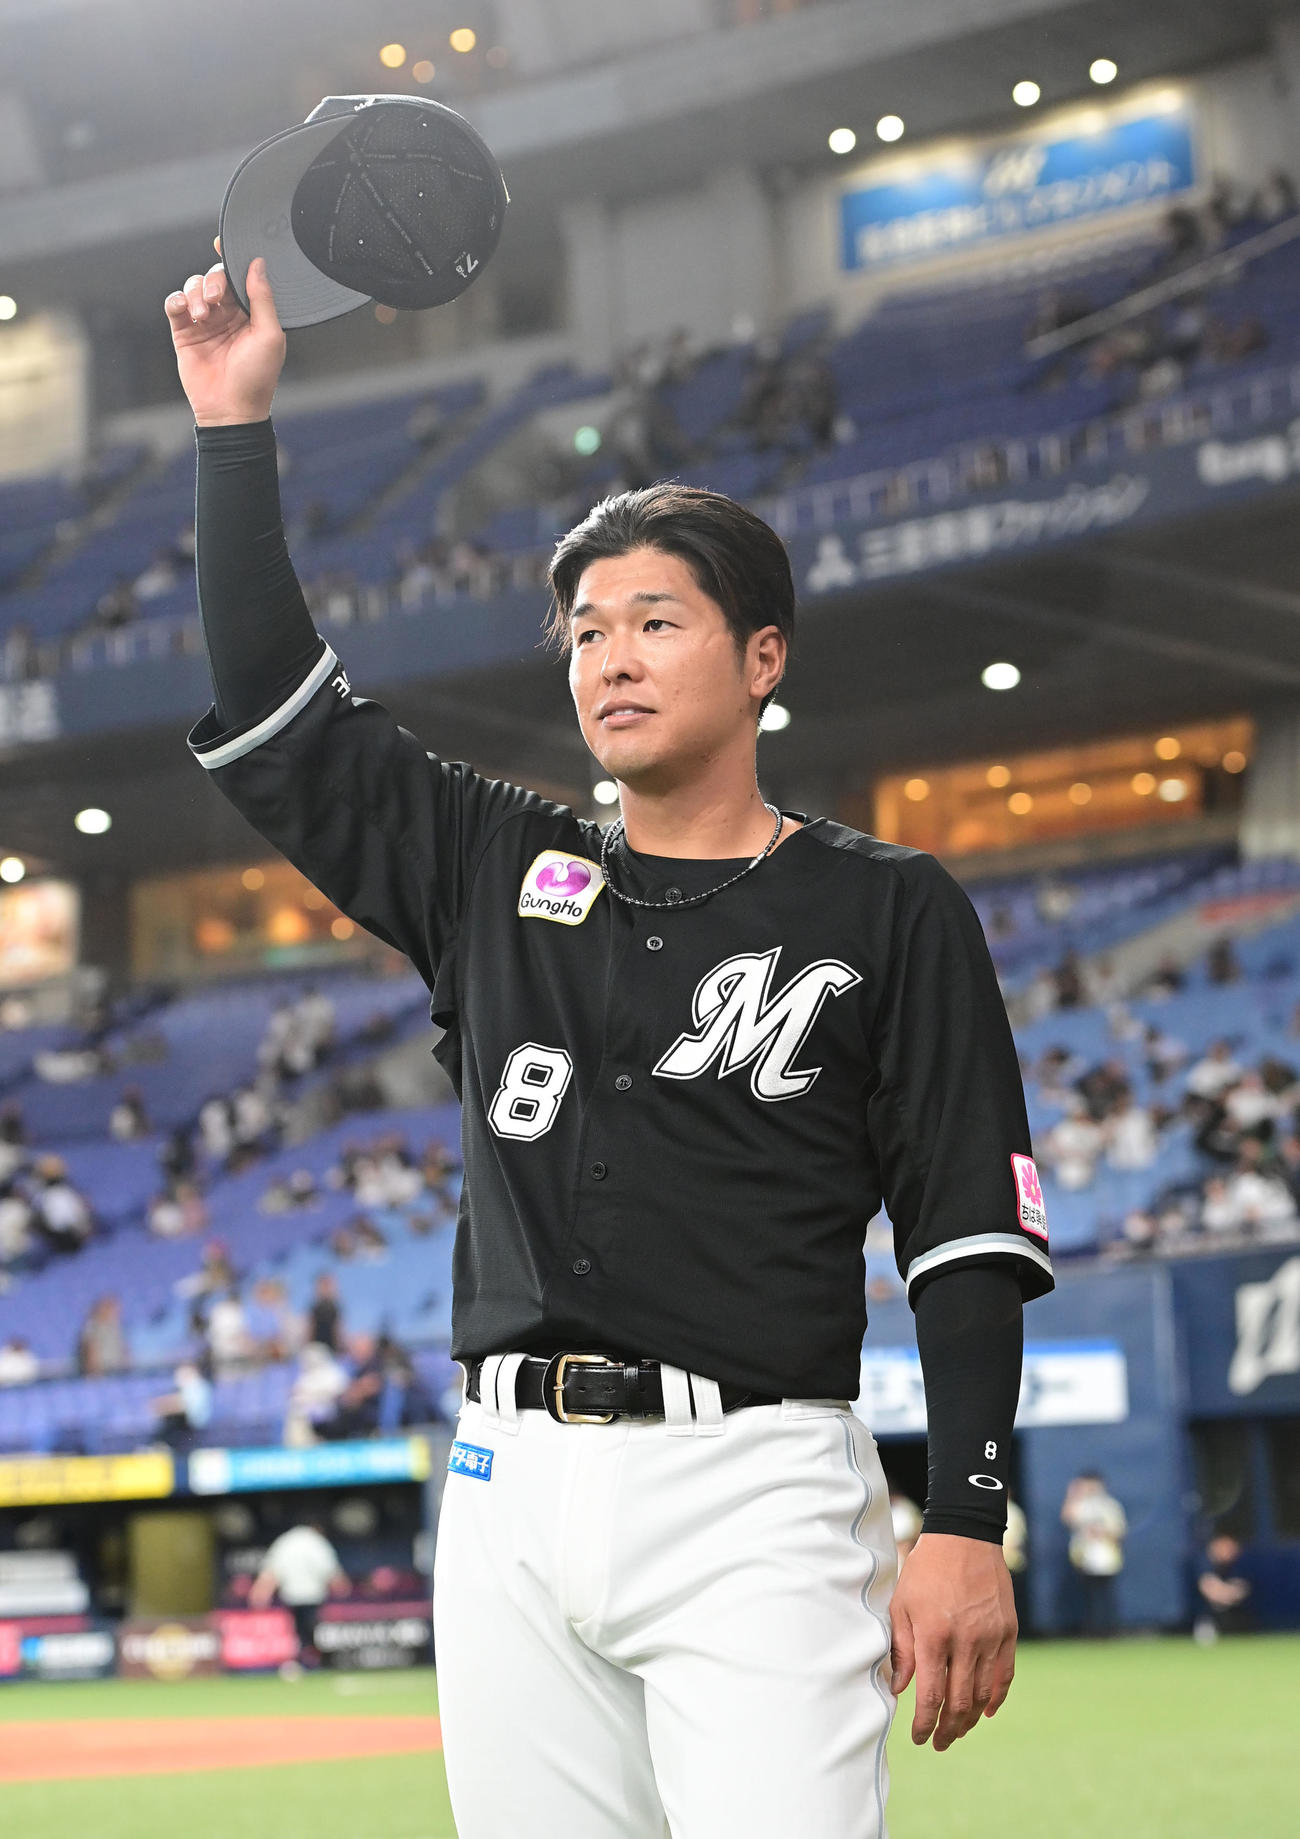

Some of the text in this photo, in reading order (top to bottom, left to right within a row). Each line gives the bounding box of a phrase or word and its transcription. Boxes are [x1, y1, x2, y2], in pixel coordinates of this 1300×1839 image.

[520, 892, 583, 917] GungHo
[651, 945, 864, 1102] M
[487, 1041, 573, 1142] 8
[984, 1440, 998, 1461] 8
